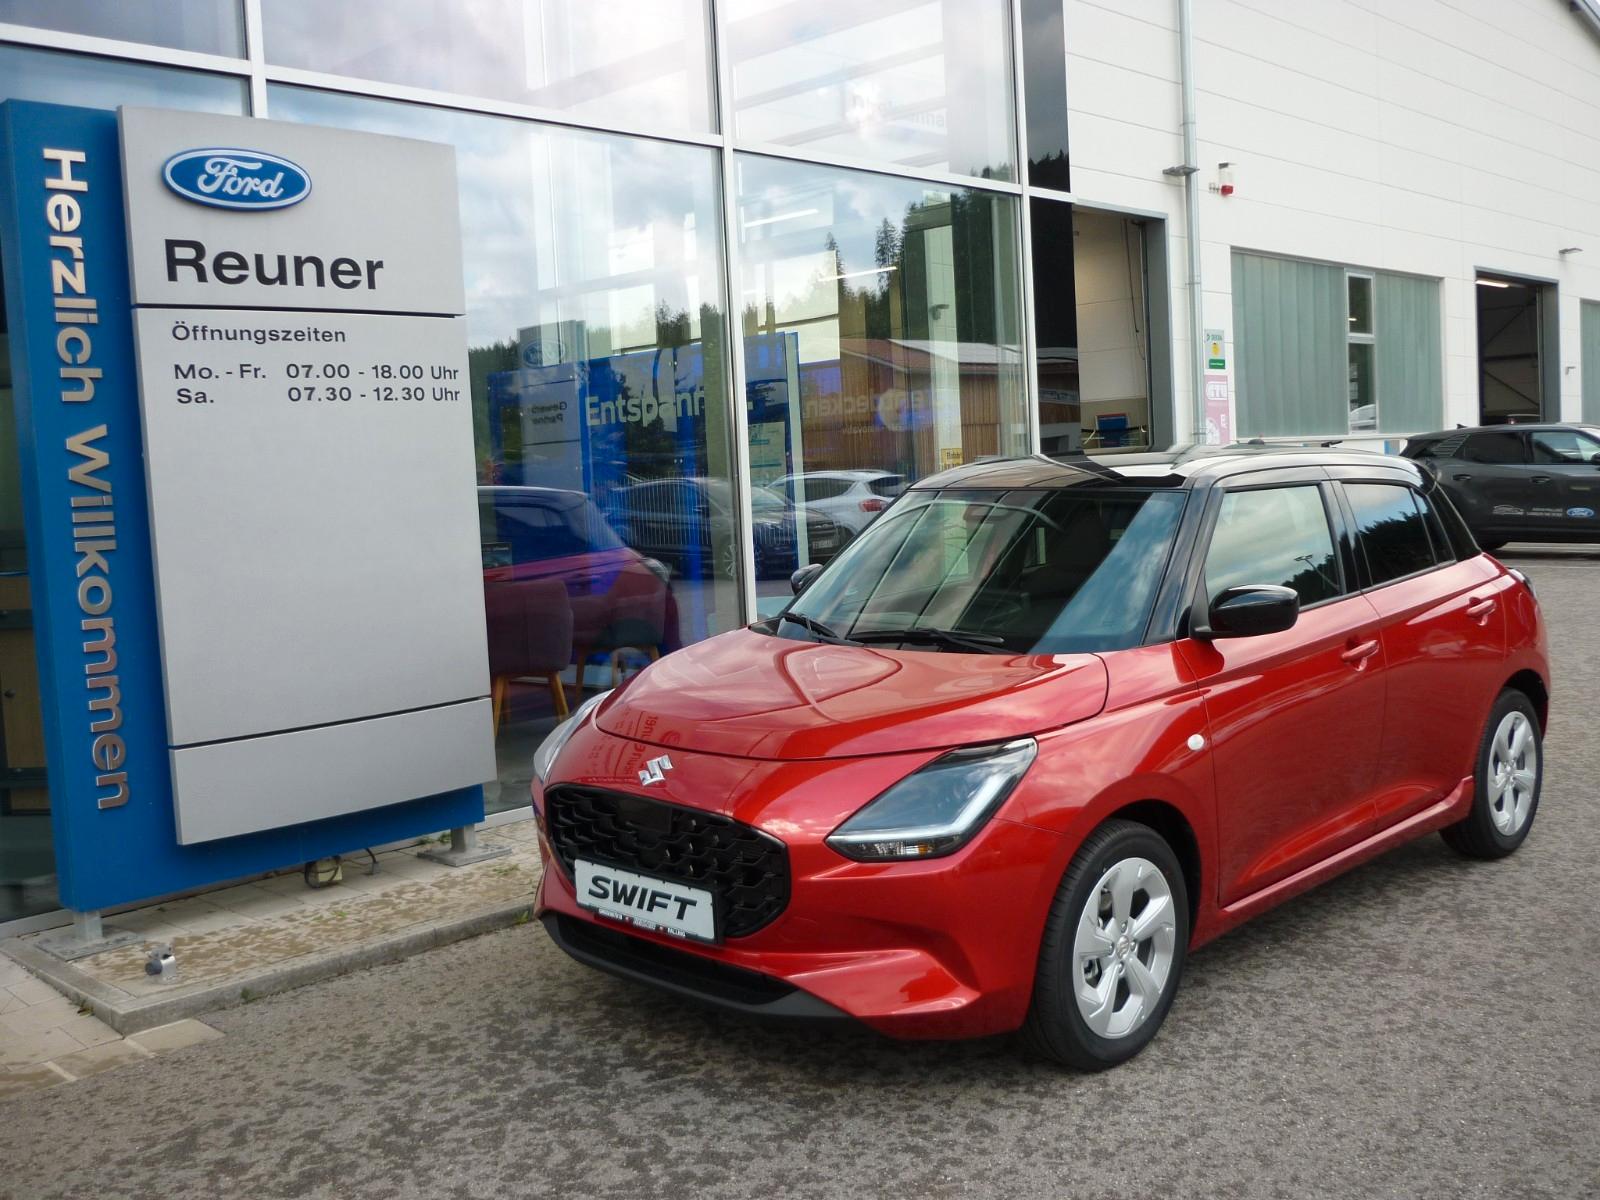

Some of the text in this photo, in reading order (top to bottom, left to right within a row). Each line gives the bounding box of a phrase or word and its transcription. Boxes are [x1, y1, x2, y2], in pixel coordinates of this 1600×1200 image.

[197, 157, 285, 198] Ford
[165, 238, 384, 290] Reuner
[172, 320, 346, 345] Öffnungszeiten
[174, 363, 220, 380] Mo.
[239, 363, 267, 379] Fr.
[286, 363, 350, 380] 07.00
[371, 364, 424, 380] 18.00
[430, 365, 459, 380] Uhr
[176, 387, 215, 405] Sa.
[287, 386, 352, 402] 07.30
[373, 386, 425, 402] 12.30
[432, 386, 460, 402] Uhr
[43, 148, 130, 810] Herzlich Willkommen
[588, 875, 698, 921] SWIFT
